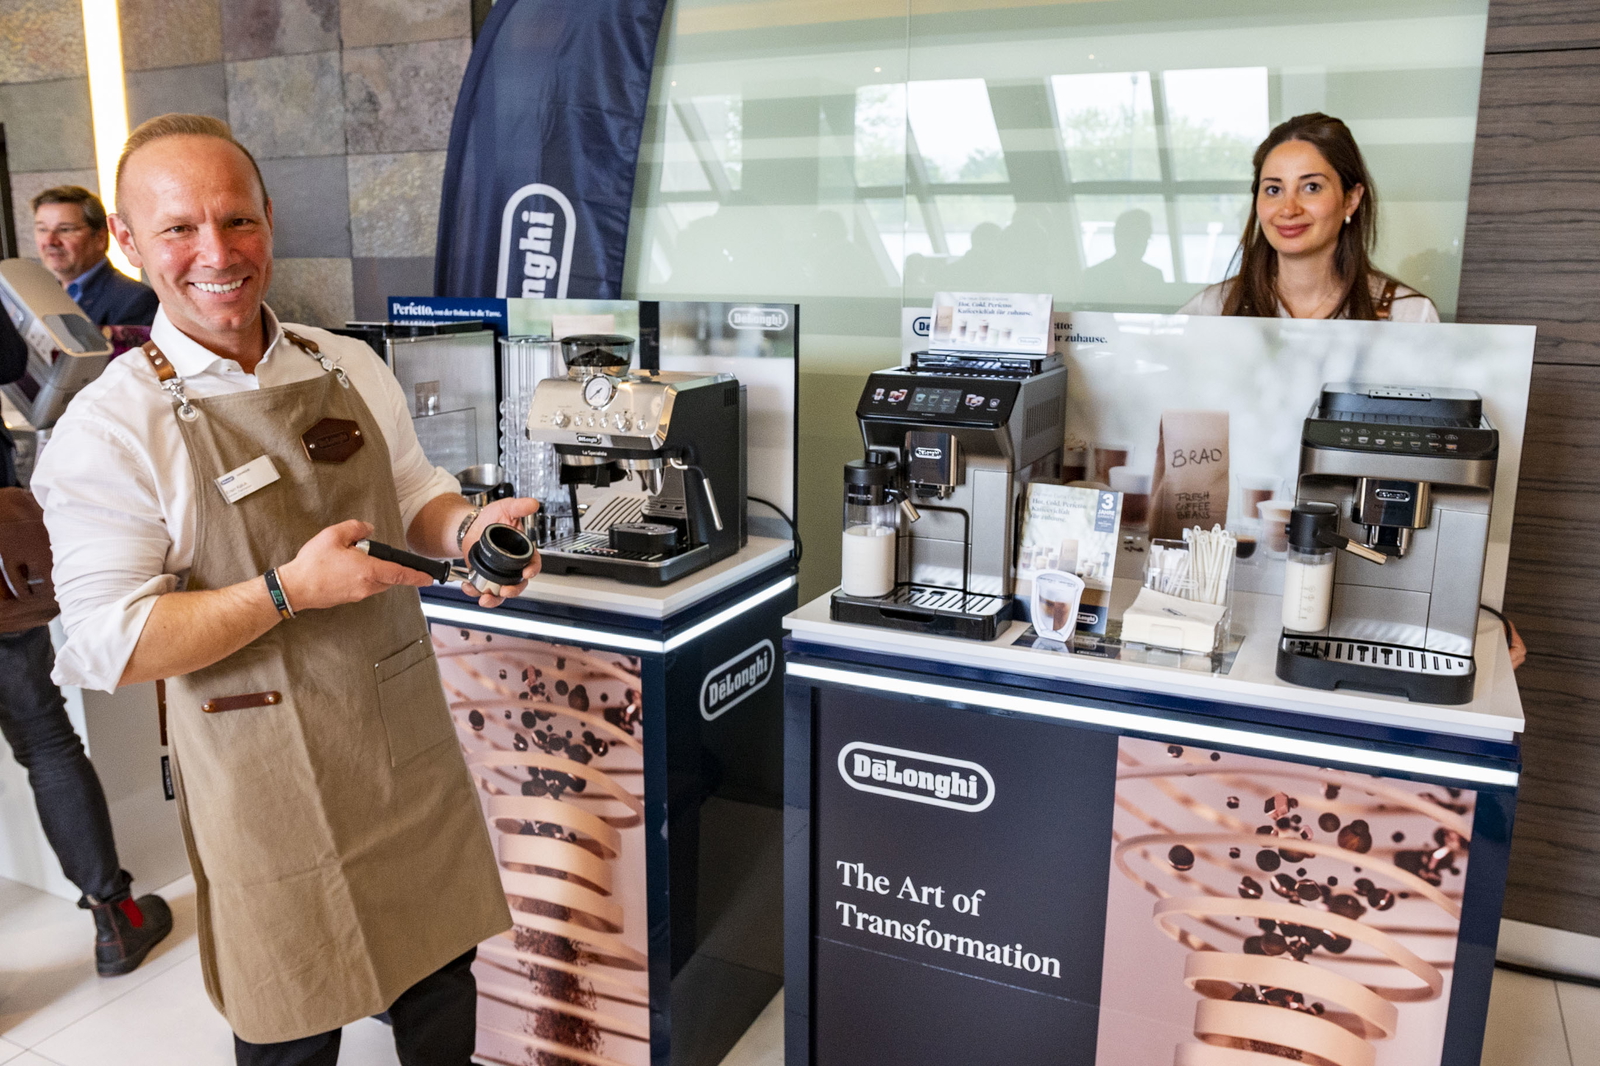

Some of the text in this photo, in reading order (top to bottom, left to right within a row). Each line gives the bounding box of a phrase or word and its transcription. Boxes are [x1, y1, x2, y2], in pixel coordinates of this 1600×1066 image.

[393, 302, 434, 316] Perfetto,
[1065, 333, 1108, 344] zuhause.
[1171, 448, 1222, 468] BRAD
[1101, 493, 1114, 510] 3
[1175, 502, 1211, 511] COFFEE
[1177, 511, 1211, 520] BEANS
[836, 860, 986, 917] The Art of
[836, 901, 1061, 978] Transformation
